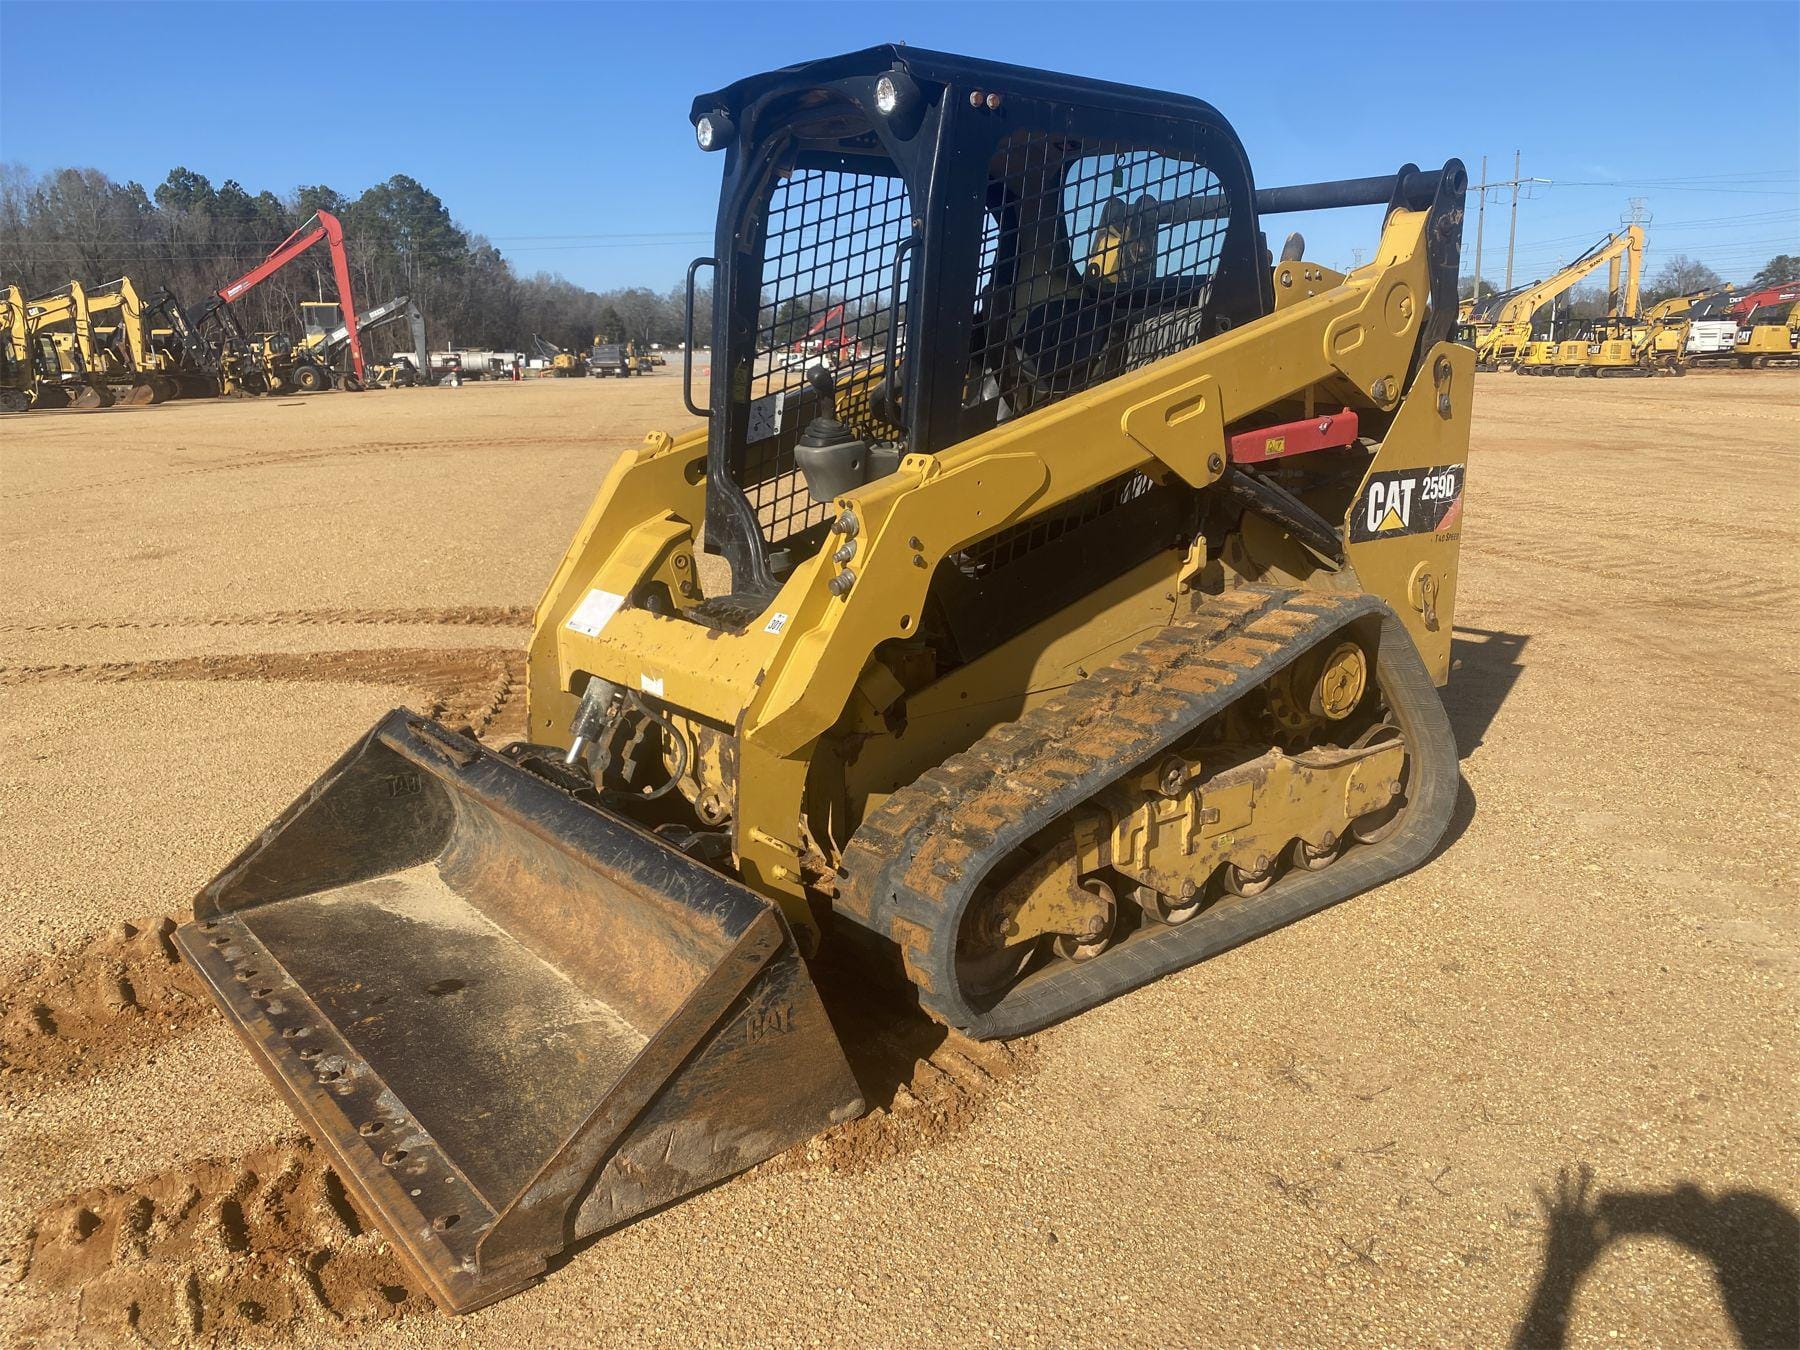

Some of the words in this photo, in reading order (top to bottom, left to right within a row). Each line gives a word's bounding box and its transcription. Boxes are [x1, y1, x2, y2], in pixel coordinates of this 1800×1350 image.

[1367, 478, 1416, 532] CAT
[1421, 474, 1455, 501] 259D
[746, 1003, 794, 1046] CAT
